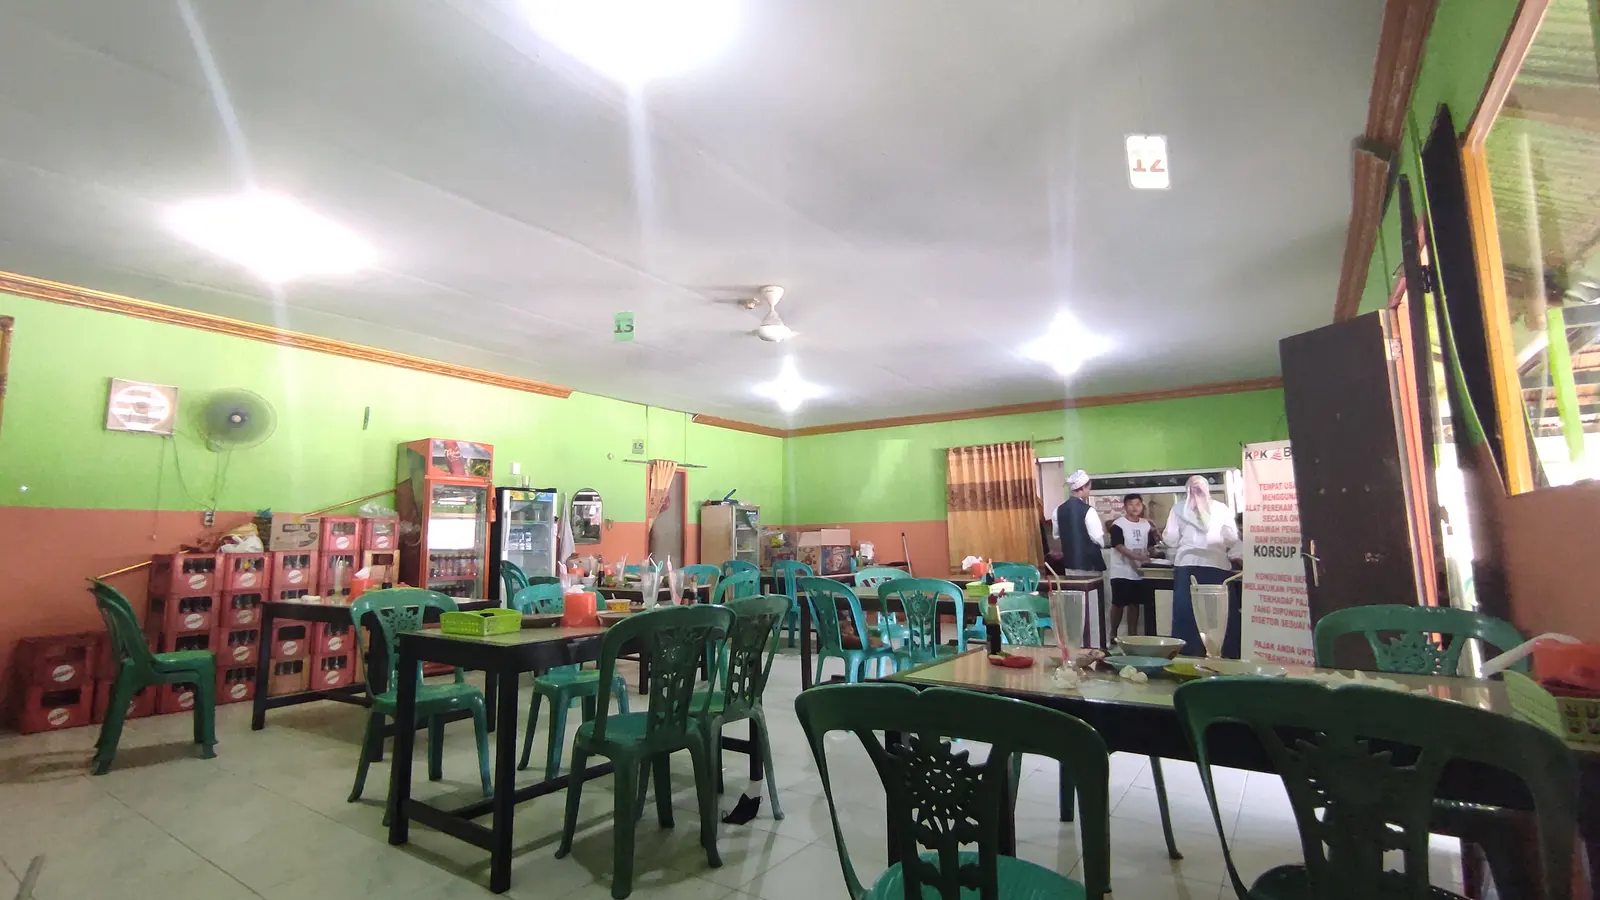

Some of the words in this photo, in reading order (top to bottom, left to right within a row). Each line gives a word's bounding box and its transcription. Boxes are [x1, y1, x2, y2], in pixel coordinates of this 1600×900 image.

[1245, 450, 1267, 460] KPK
[1259, 482, 1282, 491] TEMPAT
[1245, 504, 1261, 512] ALAT
[1262, 504, 1293, 512] PEREKAM
[1262, 514, 1288, 522] SECARA
[1249, 525, 1280, 533] DIBAWAH
[1255, 536, 1269, 544] DAN
[1253, 545, 1297, 559] KORSUP
[1255, 572, 1292, 582] KONSUMEN
[1243, 583, 1285, 593] MELAKUKAN
[1259, 594, 1293, 605] TERHADAP
[1253, 604, 1271, 613] YANG
[1272, 606, 1308, 617] DIPUNGUT
[1251, 615, 1279, 626] DISETOR
[1281, 619, 1306, 630] SESUAI
[1254, 639, 1275, 650] PAJAK
[1277, 643, 1296, 654] ANDA
